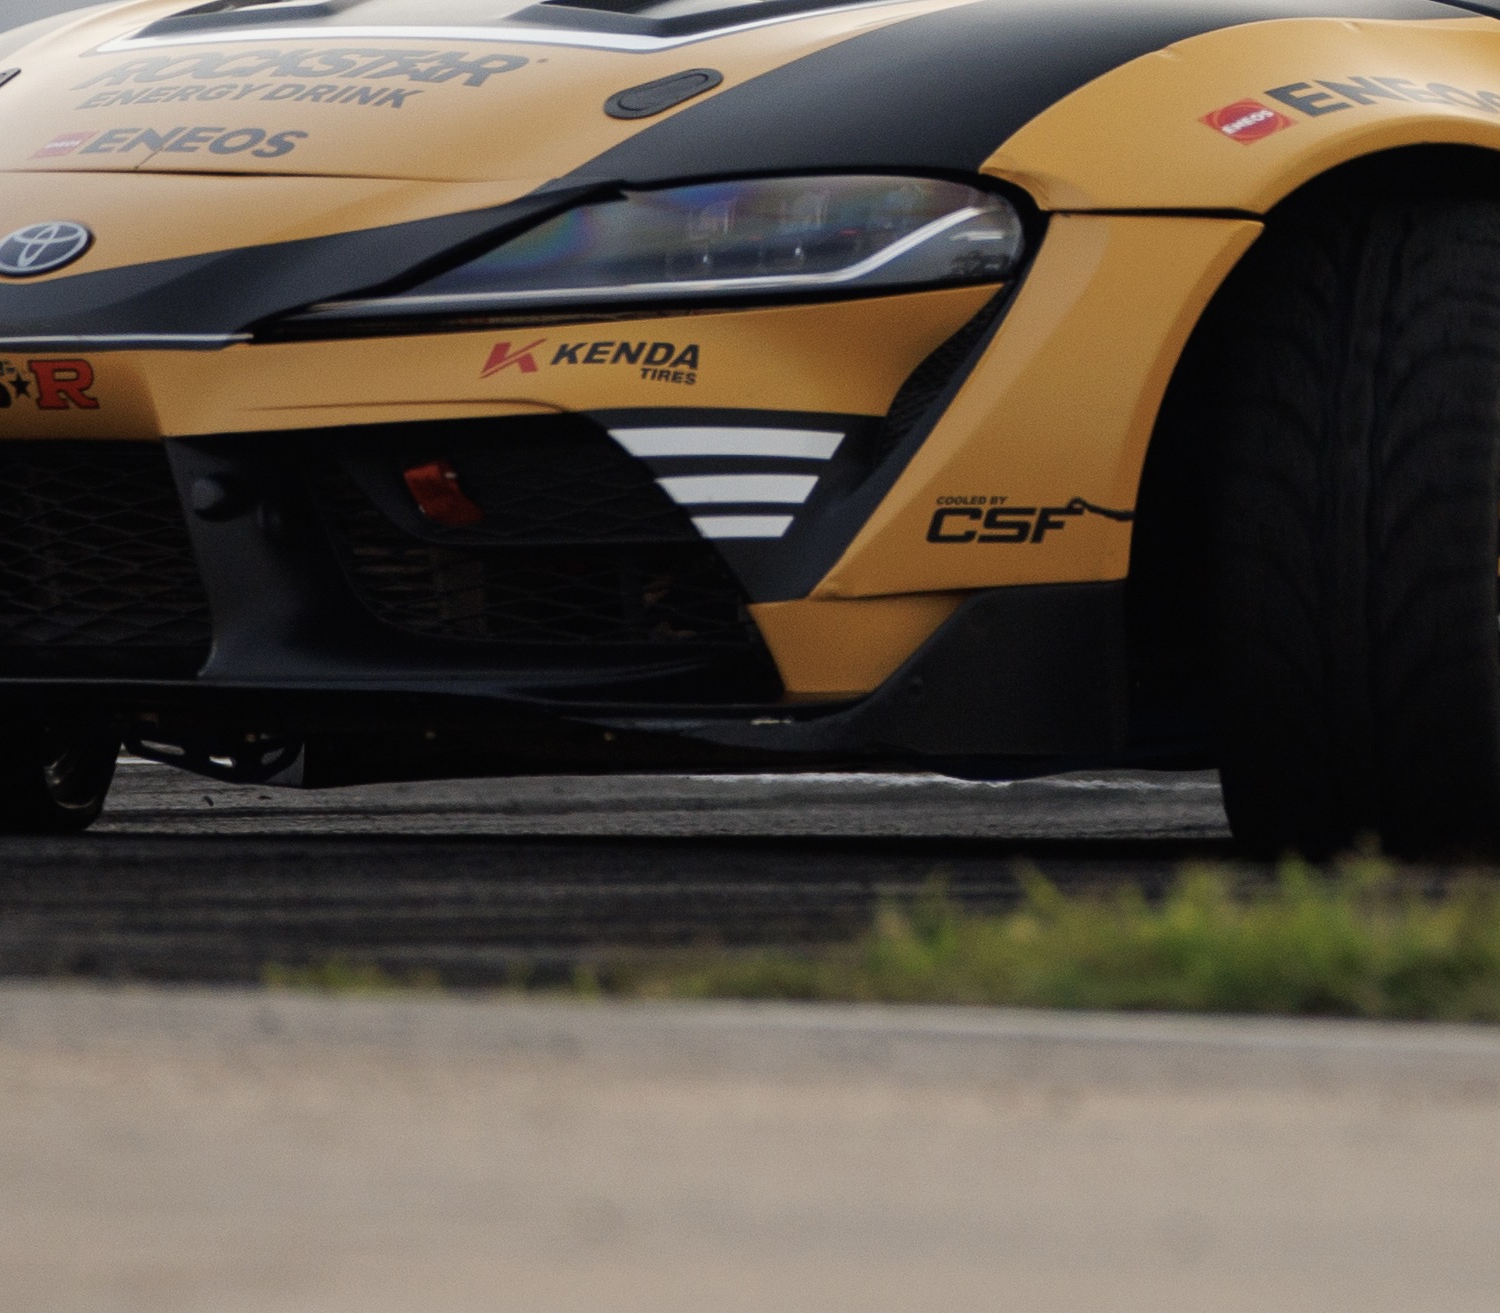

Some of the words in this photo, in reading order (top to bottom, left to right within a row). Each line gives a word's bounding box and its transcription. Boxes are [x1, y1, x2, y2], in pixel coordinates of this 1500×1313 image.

[72, 47, 529, 89] ROCKSTAR
[75, 84, 269, 110] ENERGY
[260, 84, 425, 109] DRINK
[1221, 107, 1274, 136] ENEOS
[77, 126, 309, 158] ENEOS
[551, 341, 699, 370] KENDA
[640, 367, 697, 385] TIRES
[936, 495, 987, 505] COOLED
[990, 495, 1008, 505] BY
[926, 507, 1086, 543] CSF
